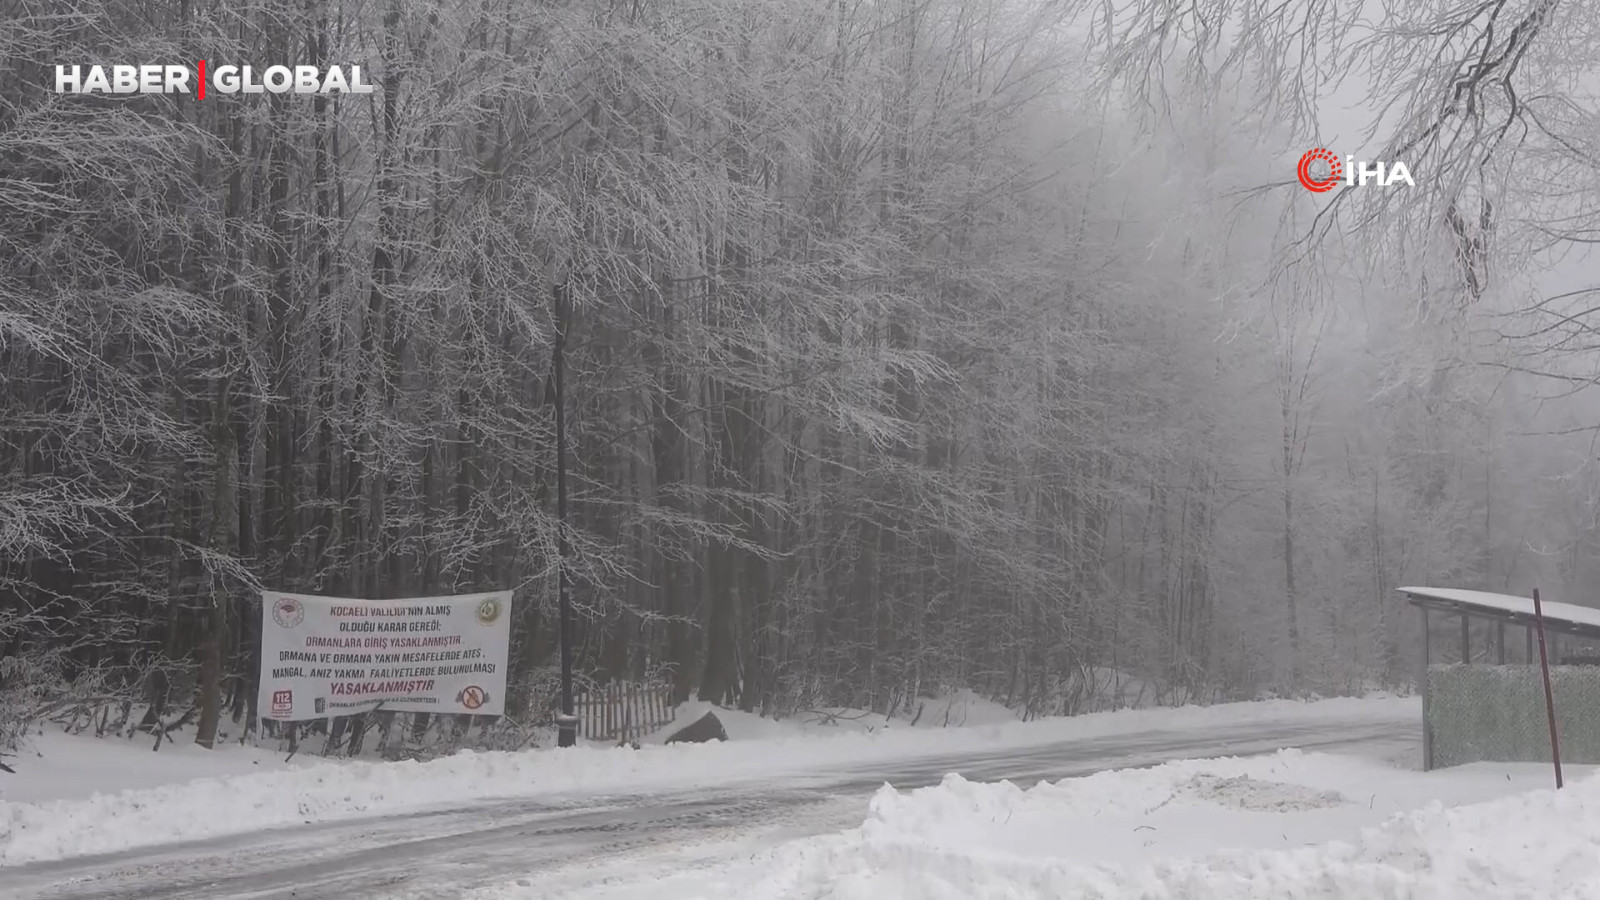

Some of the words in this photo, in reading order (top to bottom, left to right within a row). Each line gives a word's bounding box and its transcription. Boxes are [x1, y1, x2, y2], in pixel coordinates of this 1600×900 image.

[425, 605, 452, 616] ALMIŞ
[340, 621, 375, 632] OLDUĞU
[377, 622, 407, 632] KARAR
[306, 636, 362, 648] ORMANLARA
[364, 636, 388, 649] GİRİŞ
[280, 651, 317, 662] ORMANA
[320, 653, 331, 663] VE
[333, 653, 372, 664] ORMANA
[374, 653, 400, 663] YAKIN
[402, 650, 461, 663] MESAFELERDE
[310, 668, 332, 679] ANIZ
[334, 668, 365, 679] YAKMA
[370, 666, 436, 679] FAALİYETLERDE
[437, 663, 496, 676] BULUNULMASI
[330, 679, 435, 695] YASAKLANMIŞTIR
[276, 693, 290, 703] 112
